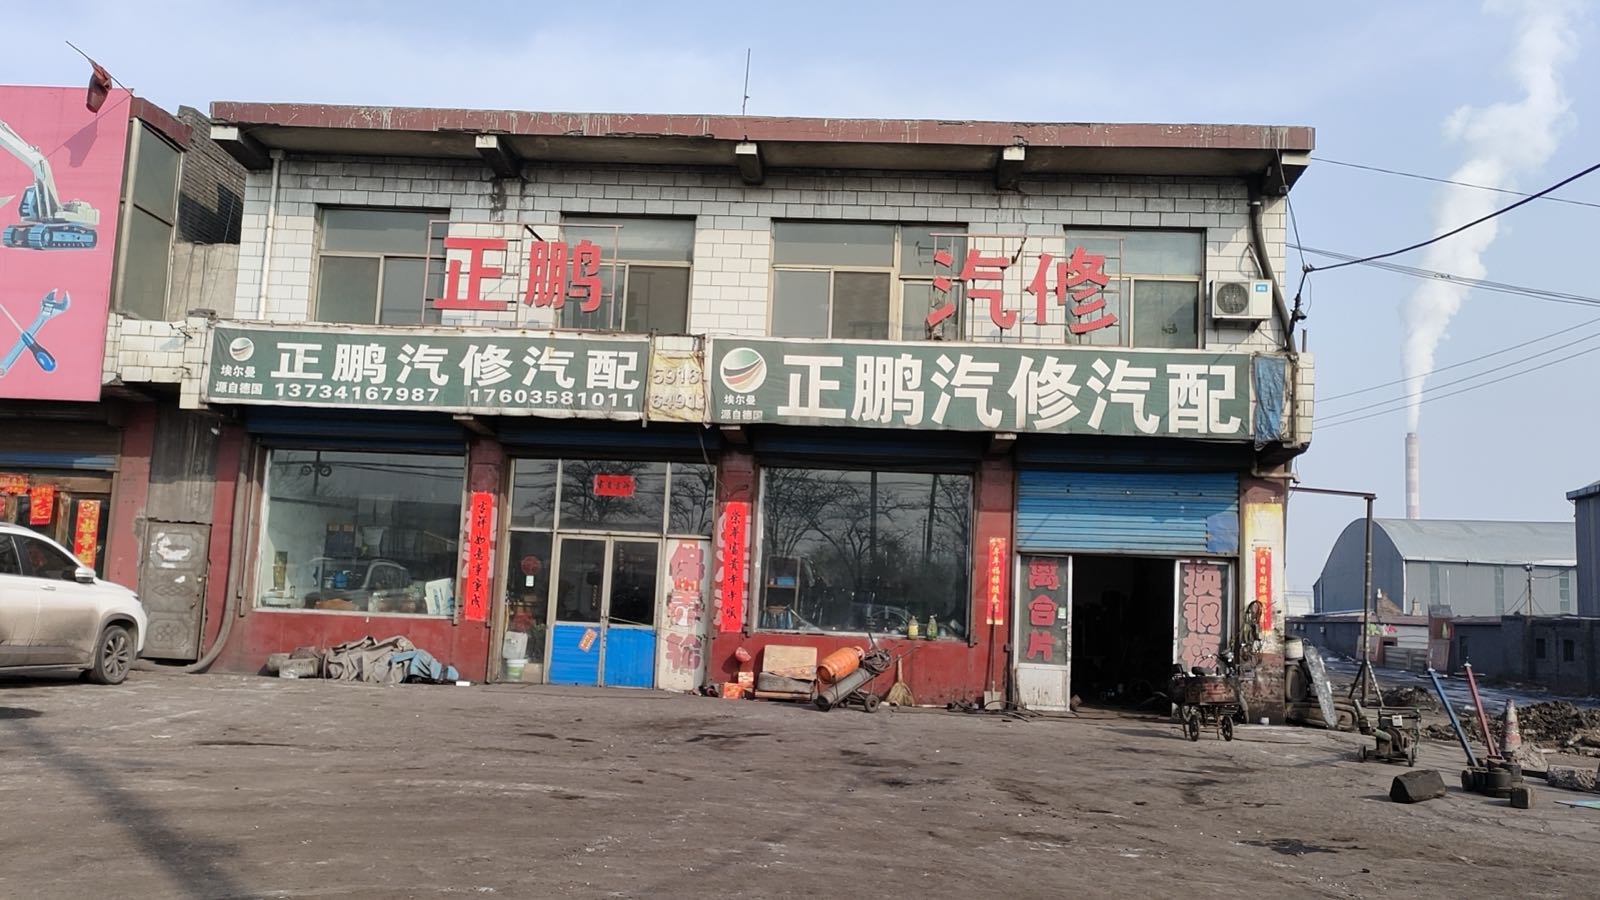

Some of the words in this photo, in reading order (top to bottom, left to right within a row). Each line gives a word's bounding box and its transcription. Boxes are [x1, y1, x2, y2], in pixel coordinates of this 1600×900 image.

[432, 236, 603, 313] 正鹏
[926, 245, 1118, 334] 汽修
[220, 365, 256, 379] 埃尔曼
[270, 342, 640, 390] 正鹏汽修汽配
[215, 381, 263, 395] 源自德国
[274, 382, 440, 402] 13734167987
[469, 388, 634, 408] 17603581011
[776, 353, 1242, 434] 正鹏汽修汽配
[723, 394, 756, 406] 埃尔曼
[720, 408, 763, 421] 源自德国
